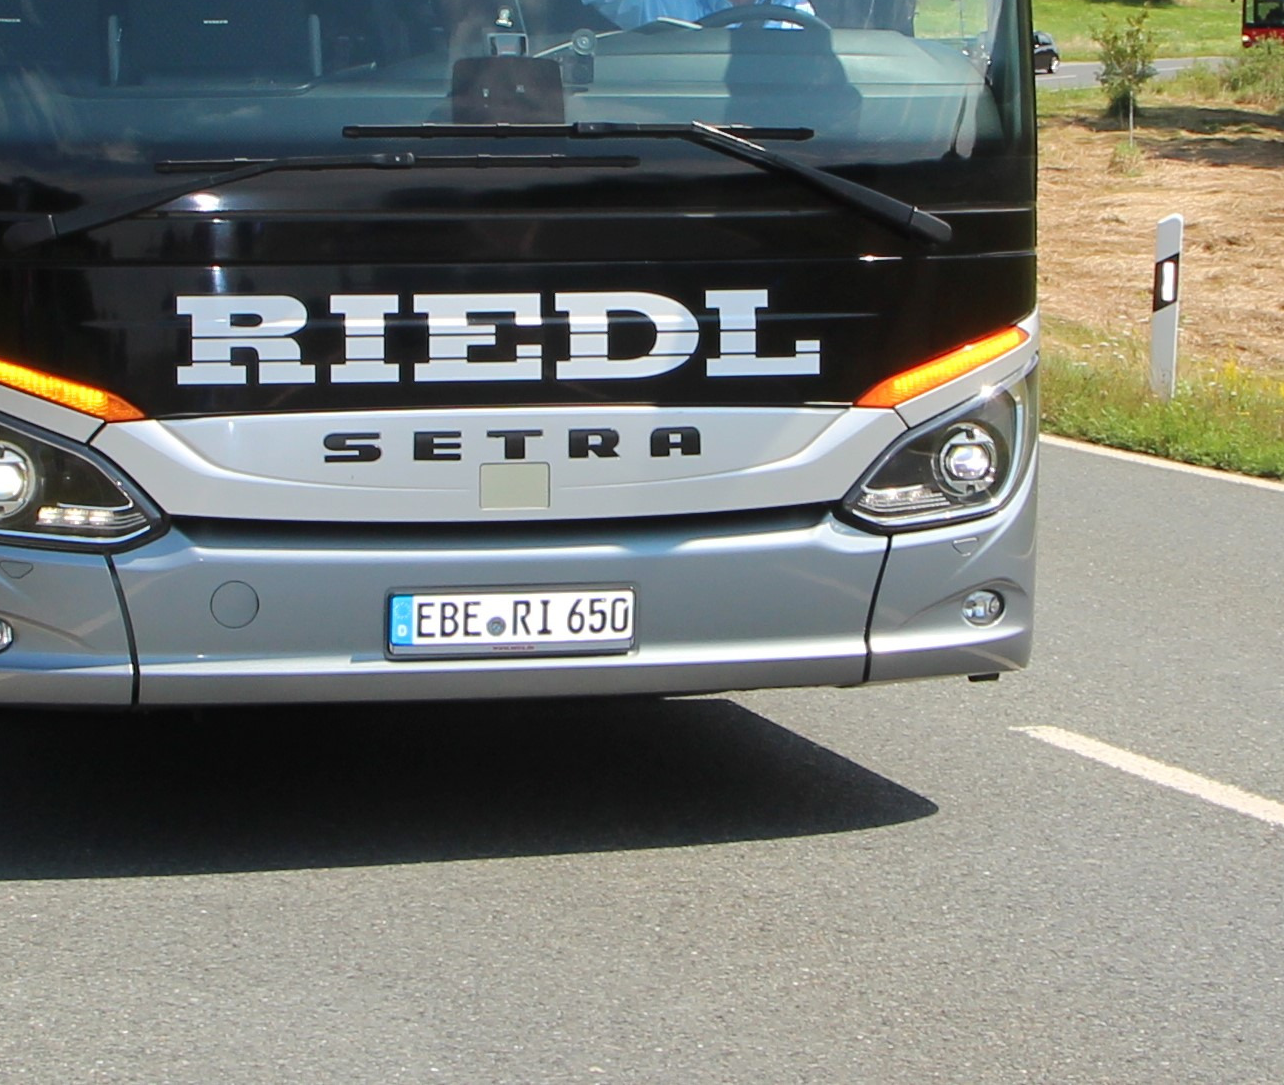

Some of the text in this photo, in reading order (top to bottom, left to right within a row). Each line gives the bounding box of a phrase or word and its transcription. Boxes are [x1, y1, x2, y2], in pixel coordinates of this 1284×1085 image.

[176, 289, 821, 385] RIEDL
[323, 426, 702, 463] SETRA
[417, 601, 482, 638] EBE
[512, 599, 552, 636] RI
[567, 597, 630, 634] 650
